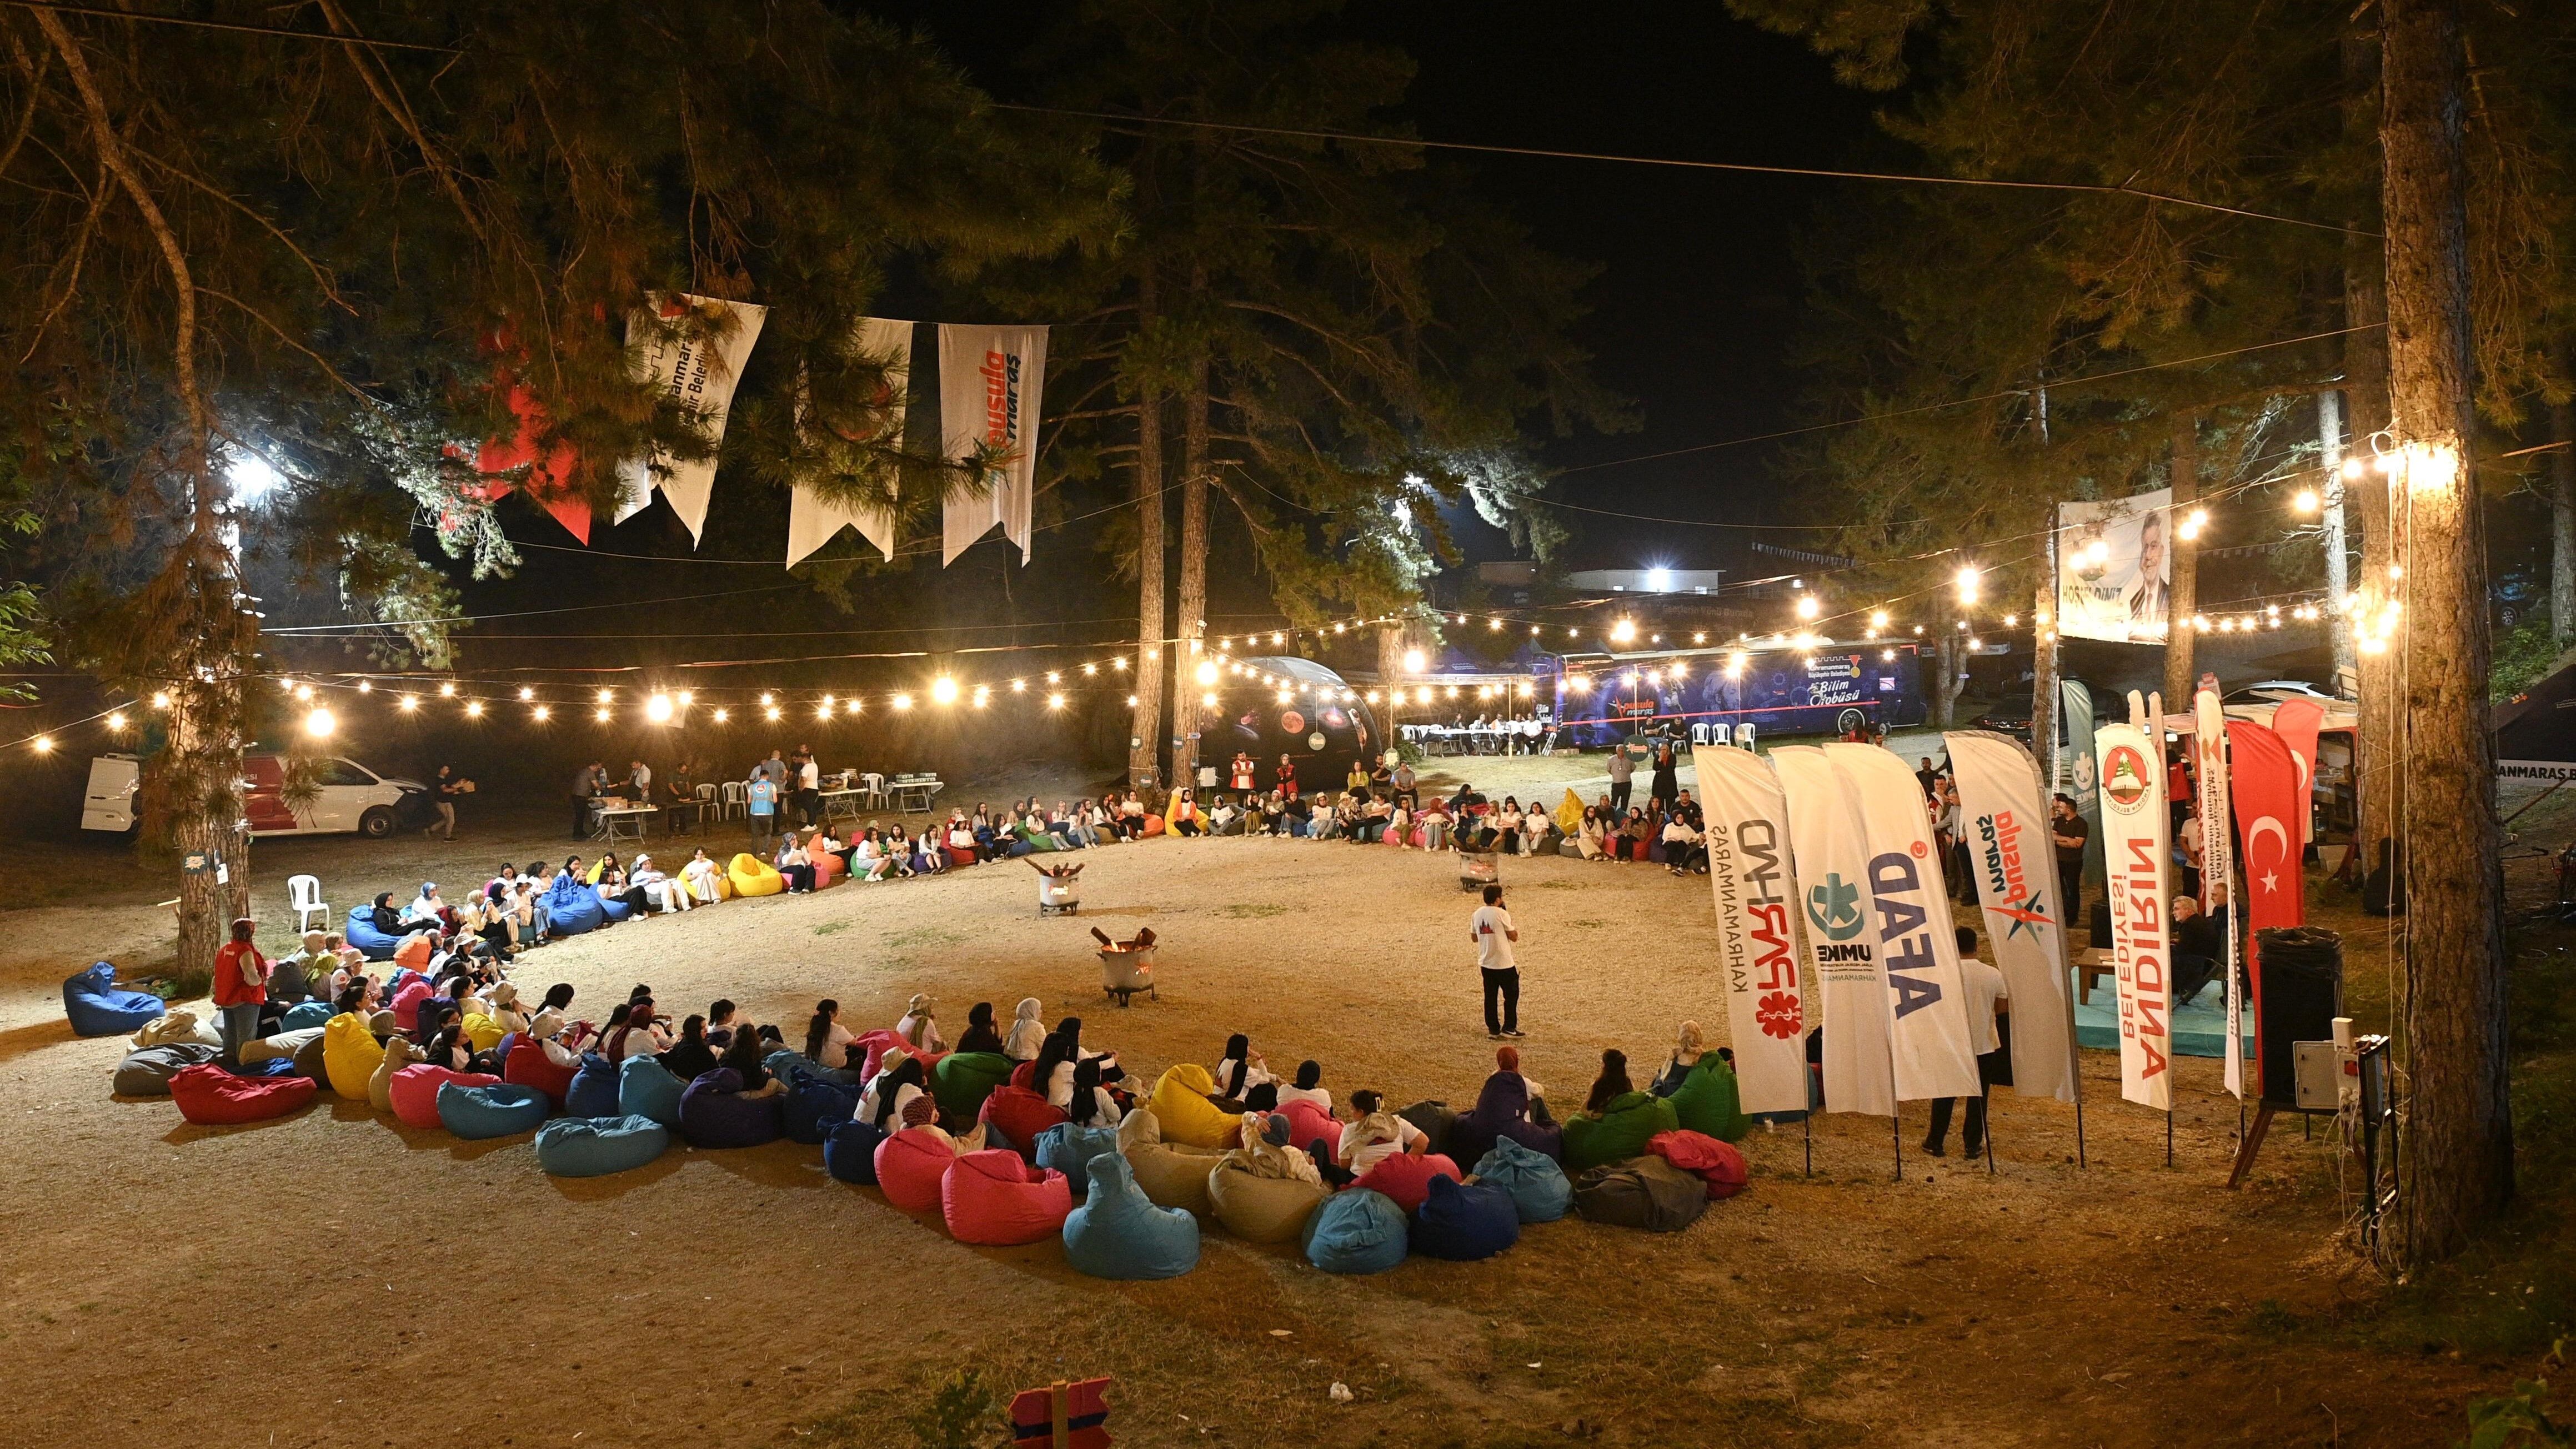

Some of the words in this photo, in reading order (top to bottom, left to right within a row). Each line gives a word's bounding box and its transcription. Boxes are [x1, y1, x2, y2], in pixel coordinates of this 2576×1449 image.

[979, 350, 1008, 448] pusula
[1006, 353, 1021, 439] maraş
[1820, 680, 1849, 693] Bilim
[1810, 690, 1860, 706] Otobüsü
[2498, 766, 2566, 781] ANMARAŞ
